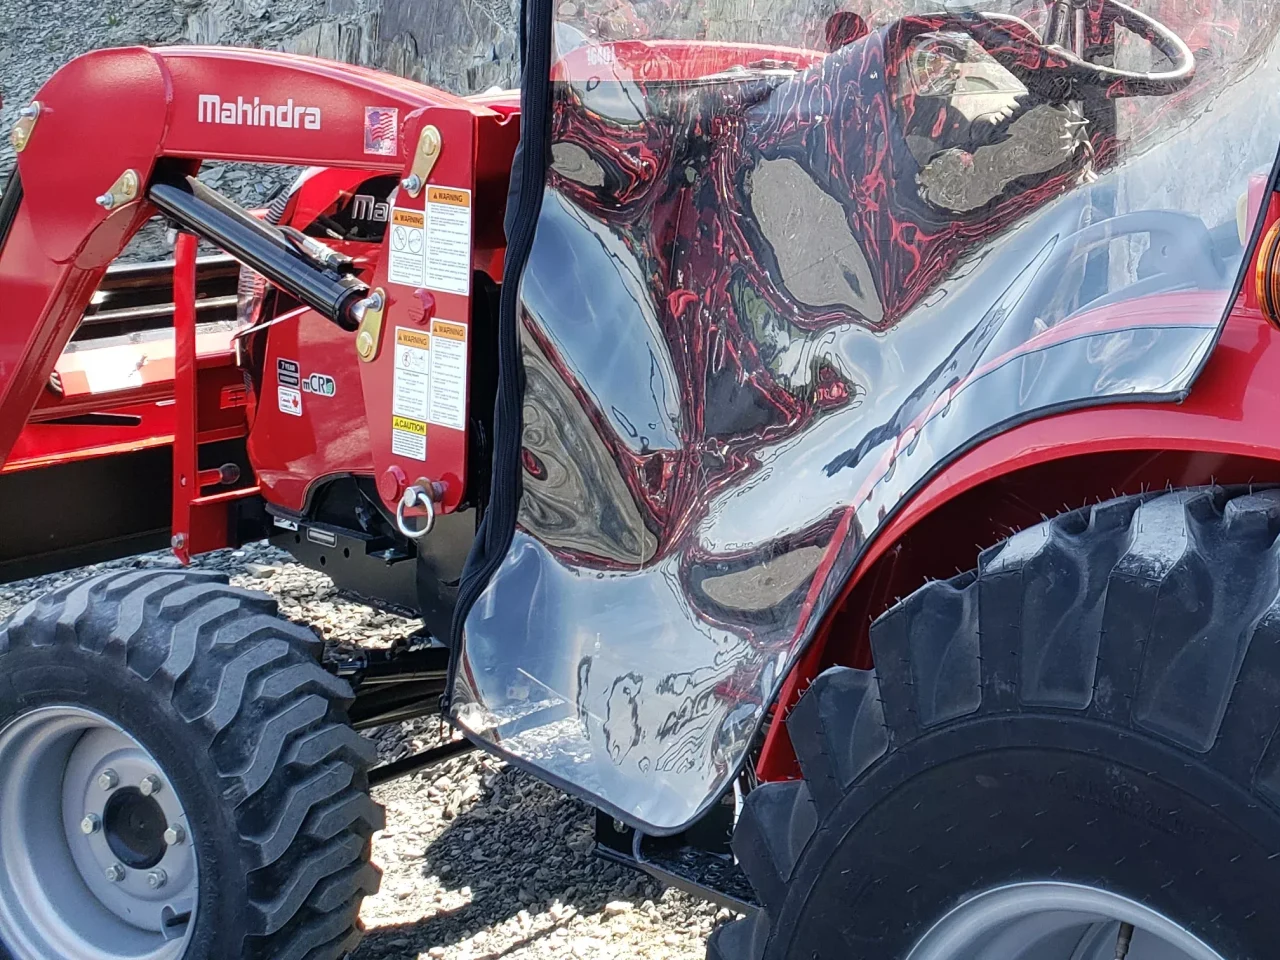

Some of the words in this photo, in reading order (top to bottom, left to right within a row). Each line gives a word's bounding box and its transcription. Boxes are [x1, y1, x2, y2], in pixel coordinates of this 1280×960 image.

[198, 94, 321, 130] Mahindra
[438, 193, 463, 202] WARNING
[351, 194, 389, 222] Ma
[400, 215, 424, 225] WARNING
[438, 325, 464, 337] WARNING
[403, 334, 427, 346] WARNING
[399, 420, 425, 432] CAUTION
